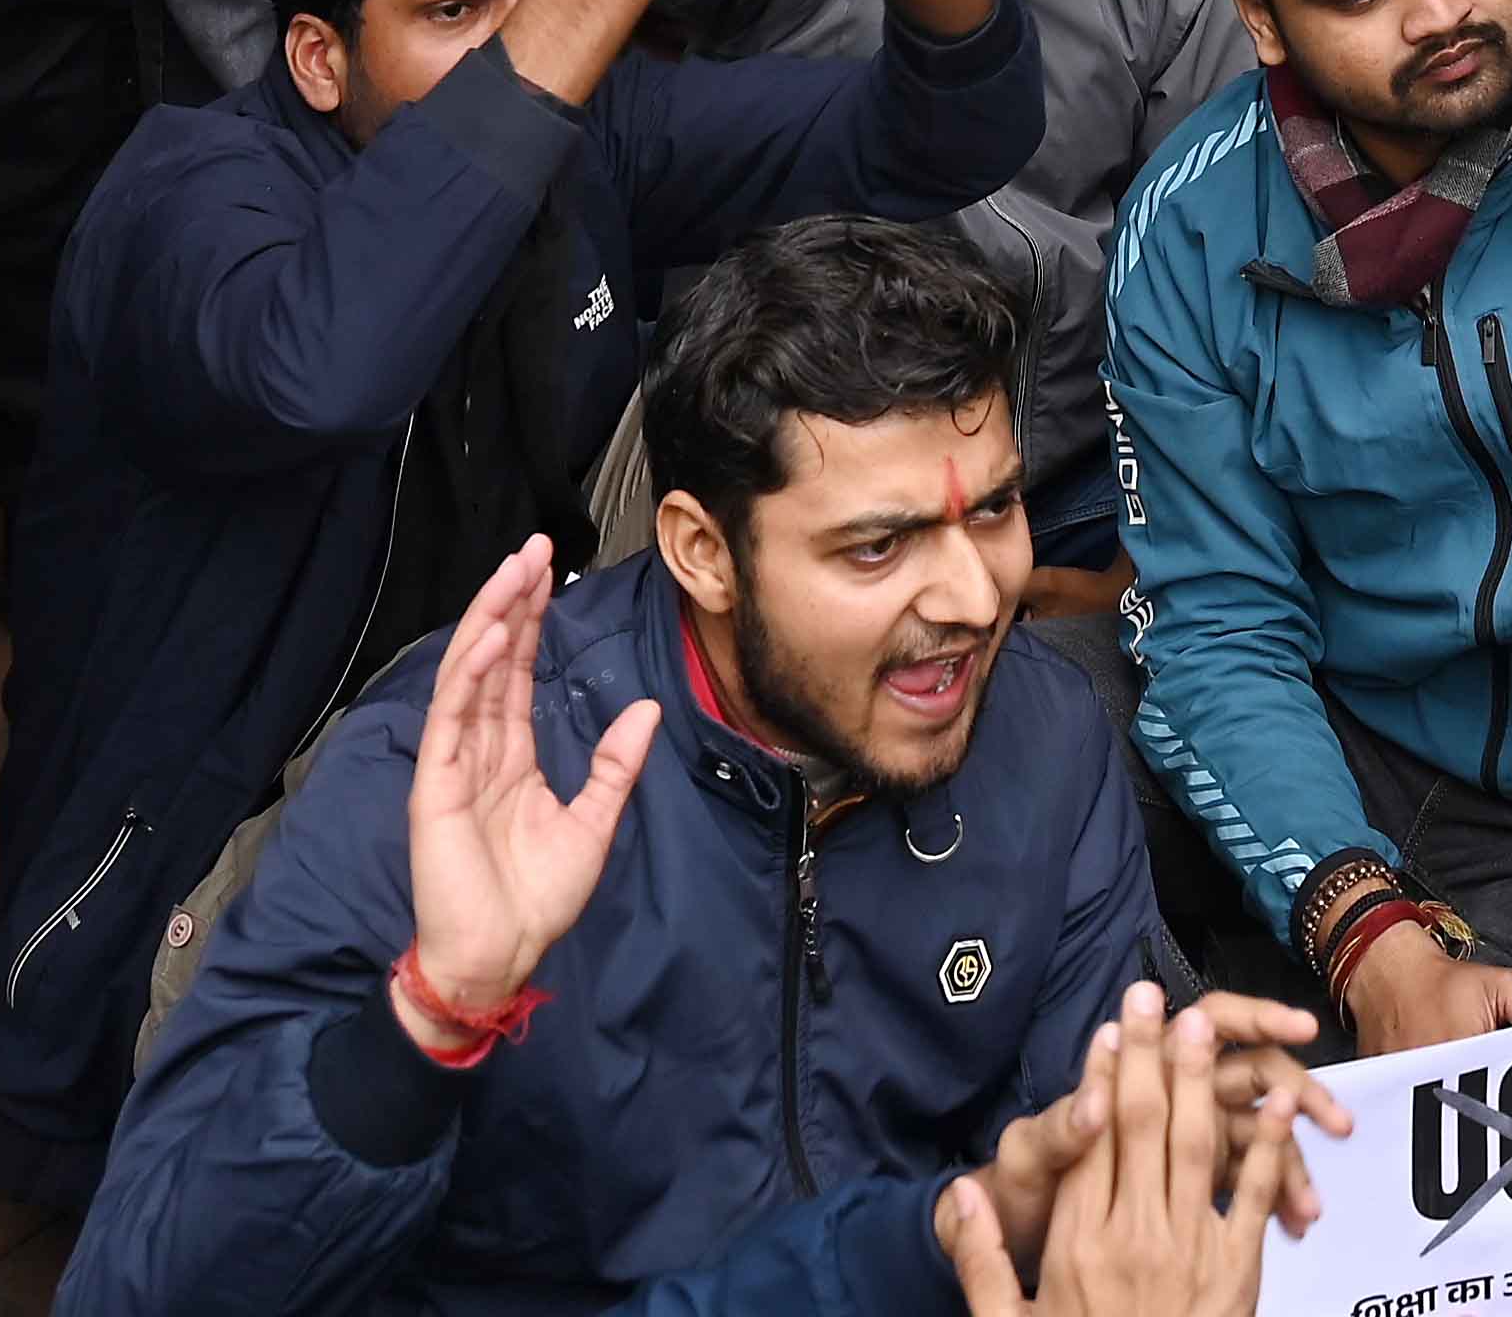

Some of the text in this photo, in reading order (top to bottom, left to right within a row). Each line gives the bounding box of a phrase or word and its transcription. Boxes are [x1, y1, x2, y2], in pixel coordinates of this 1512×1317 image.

[588, 273, 609, 303] THE
[574, 291, 612, 330] NORTH
[589, 299, 614, 332] FACE
[1445, 1270, 1491, 1307] का
